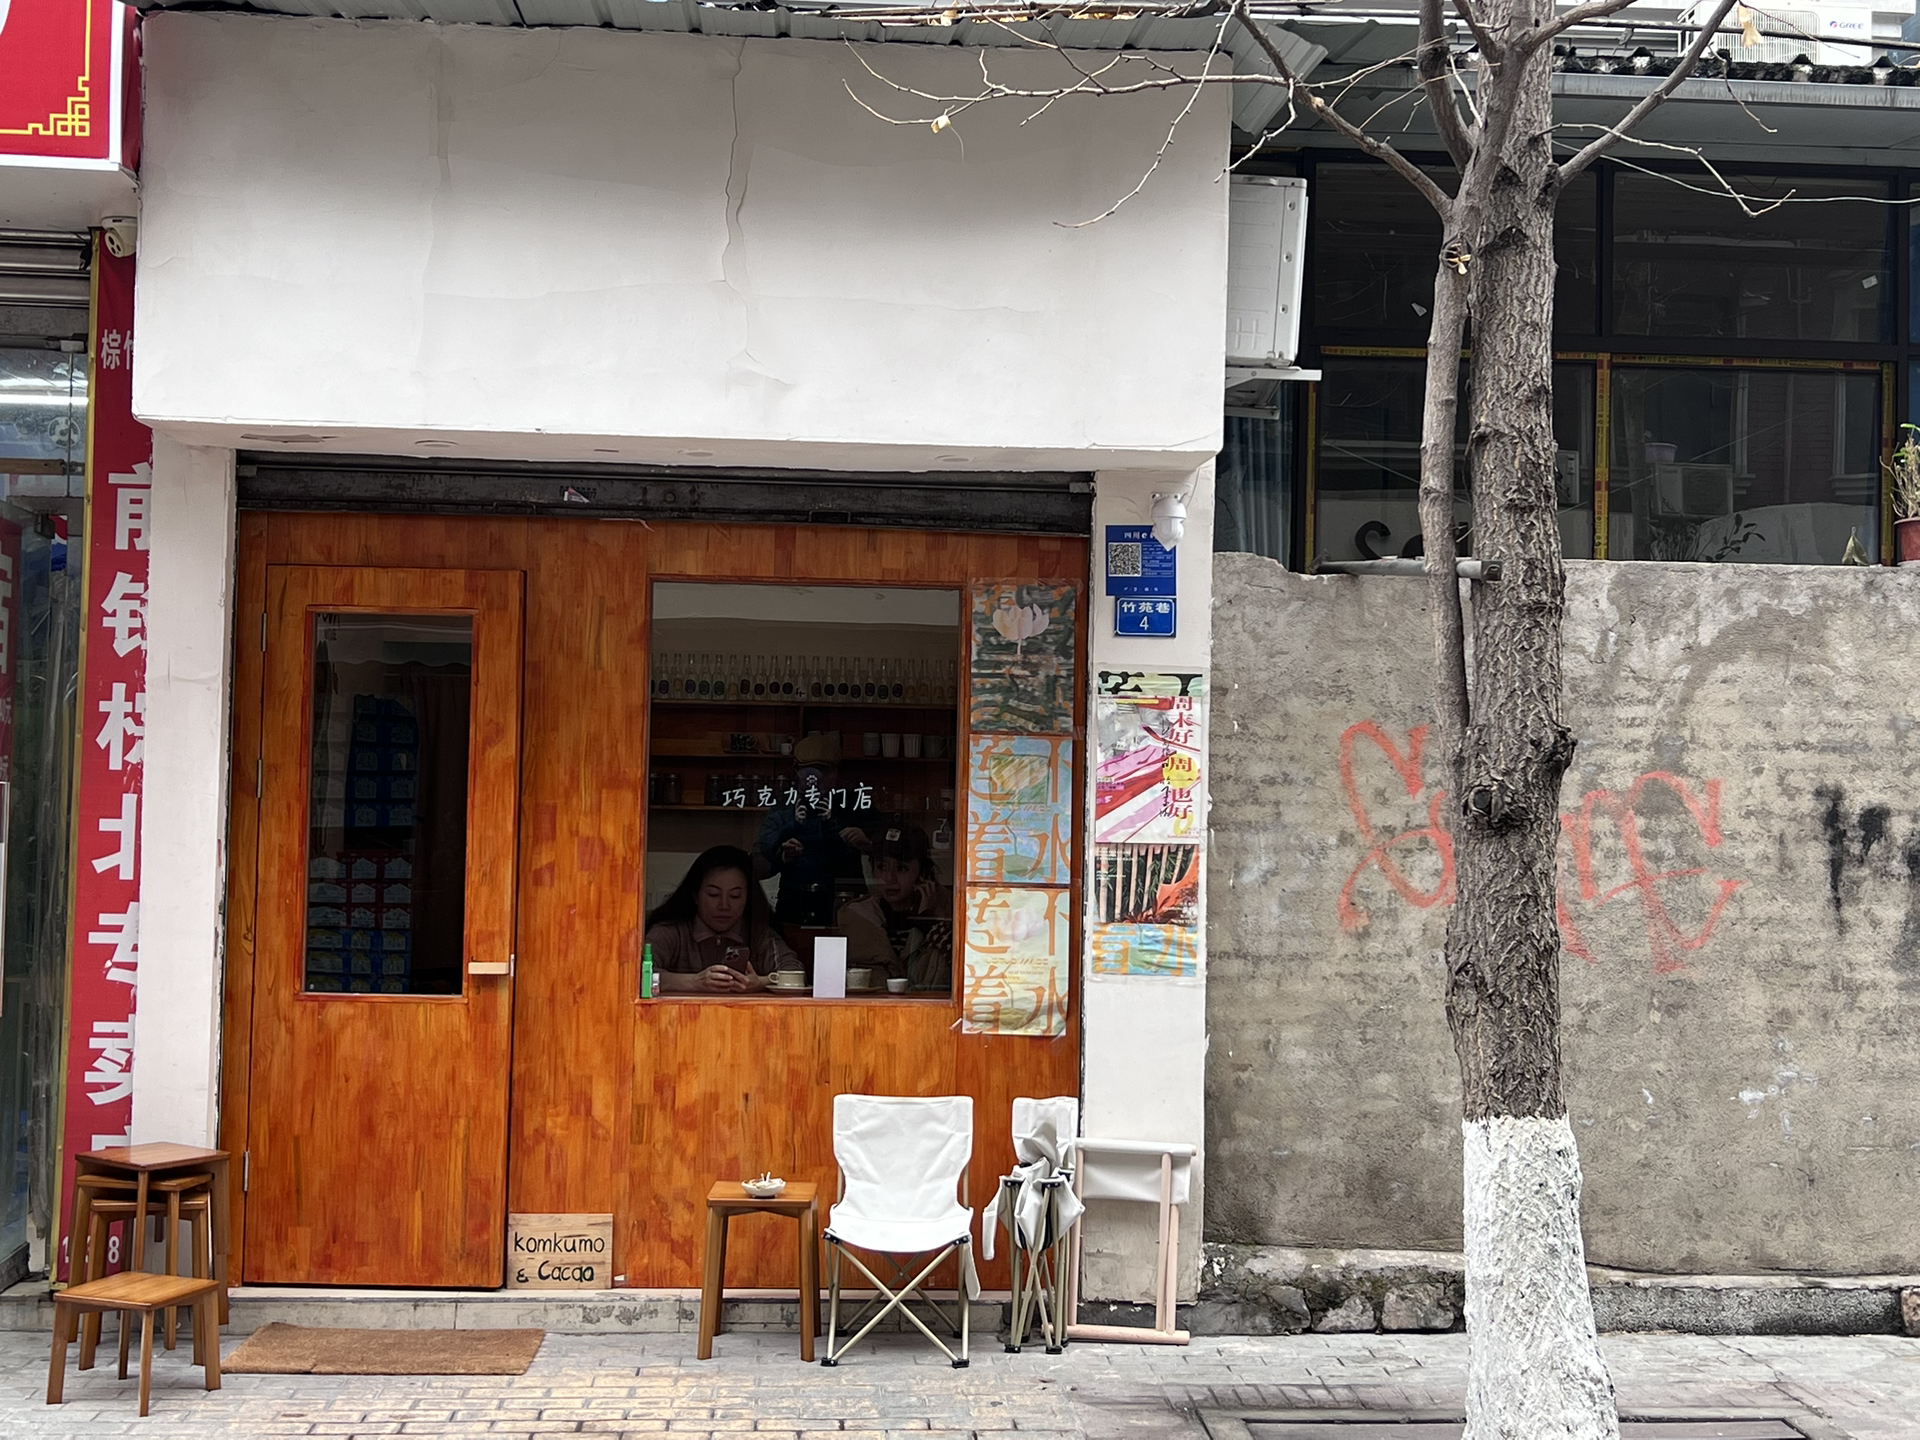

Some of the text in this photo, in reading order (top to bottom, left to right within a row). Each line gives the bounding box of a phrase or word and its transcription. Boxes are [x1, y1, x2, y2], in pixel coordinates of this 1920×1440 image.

[1839, 21, 1864, 29] GREE
[1121, 601, 1170, 614] 竹苑巷
[1139, 615, 1149, 631] 4
[722, 782, 873, 811] 巧克力专门店
